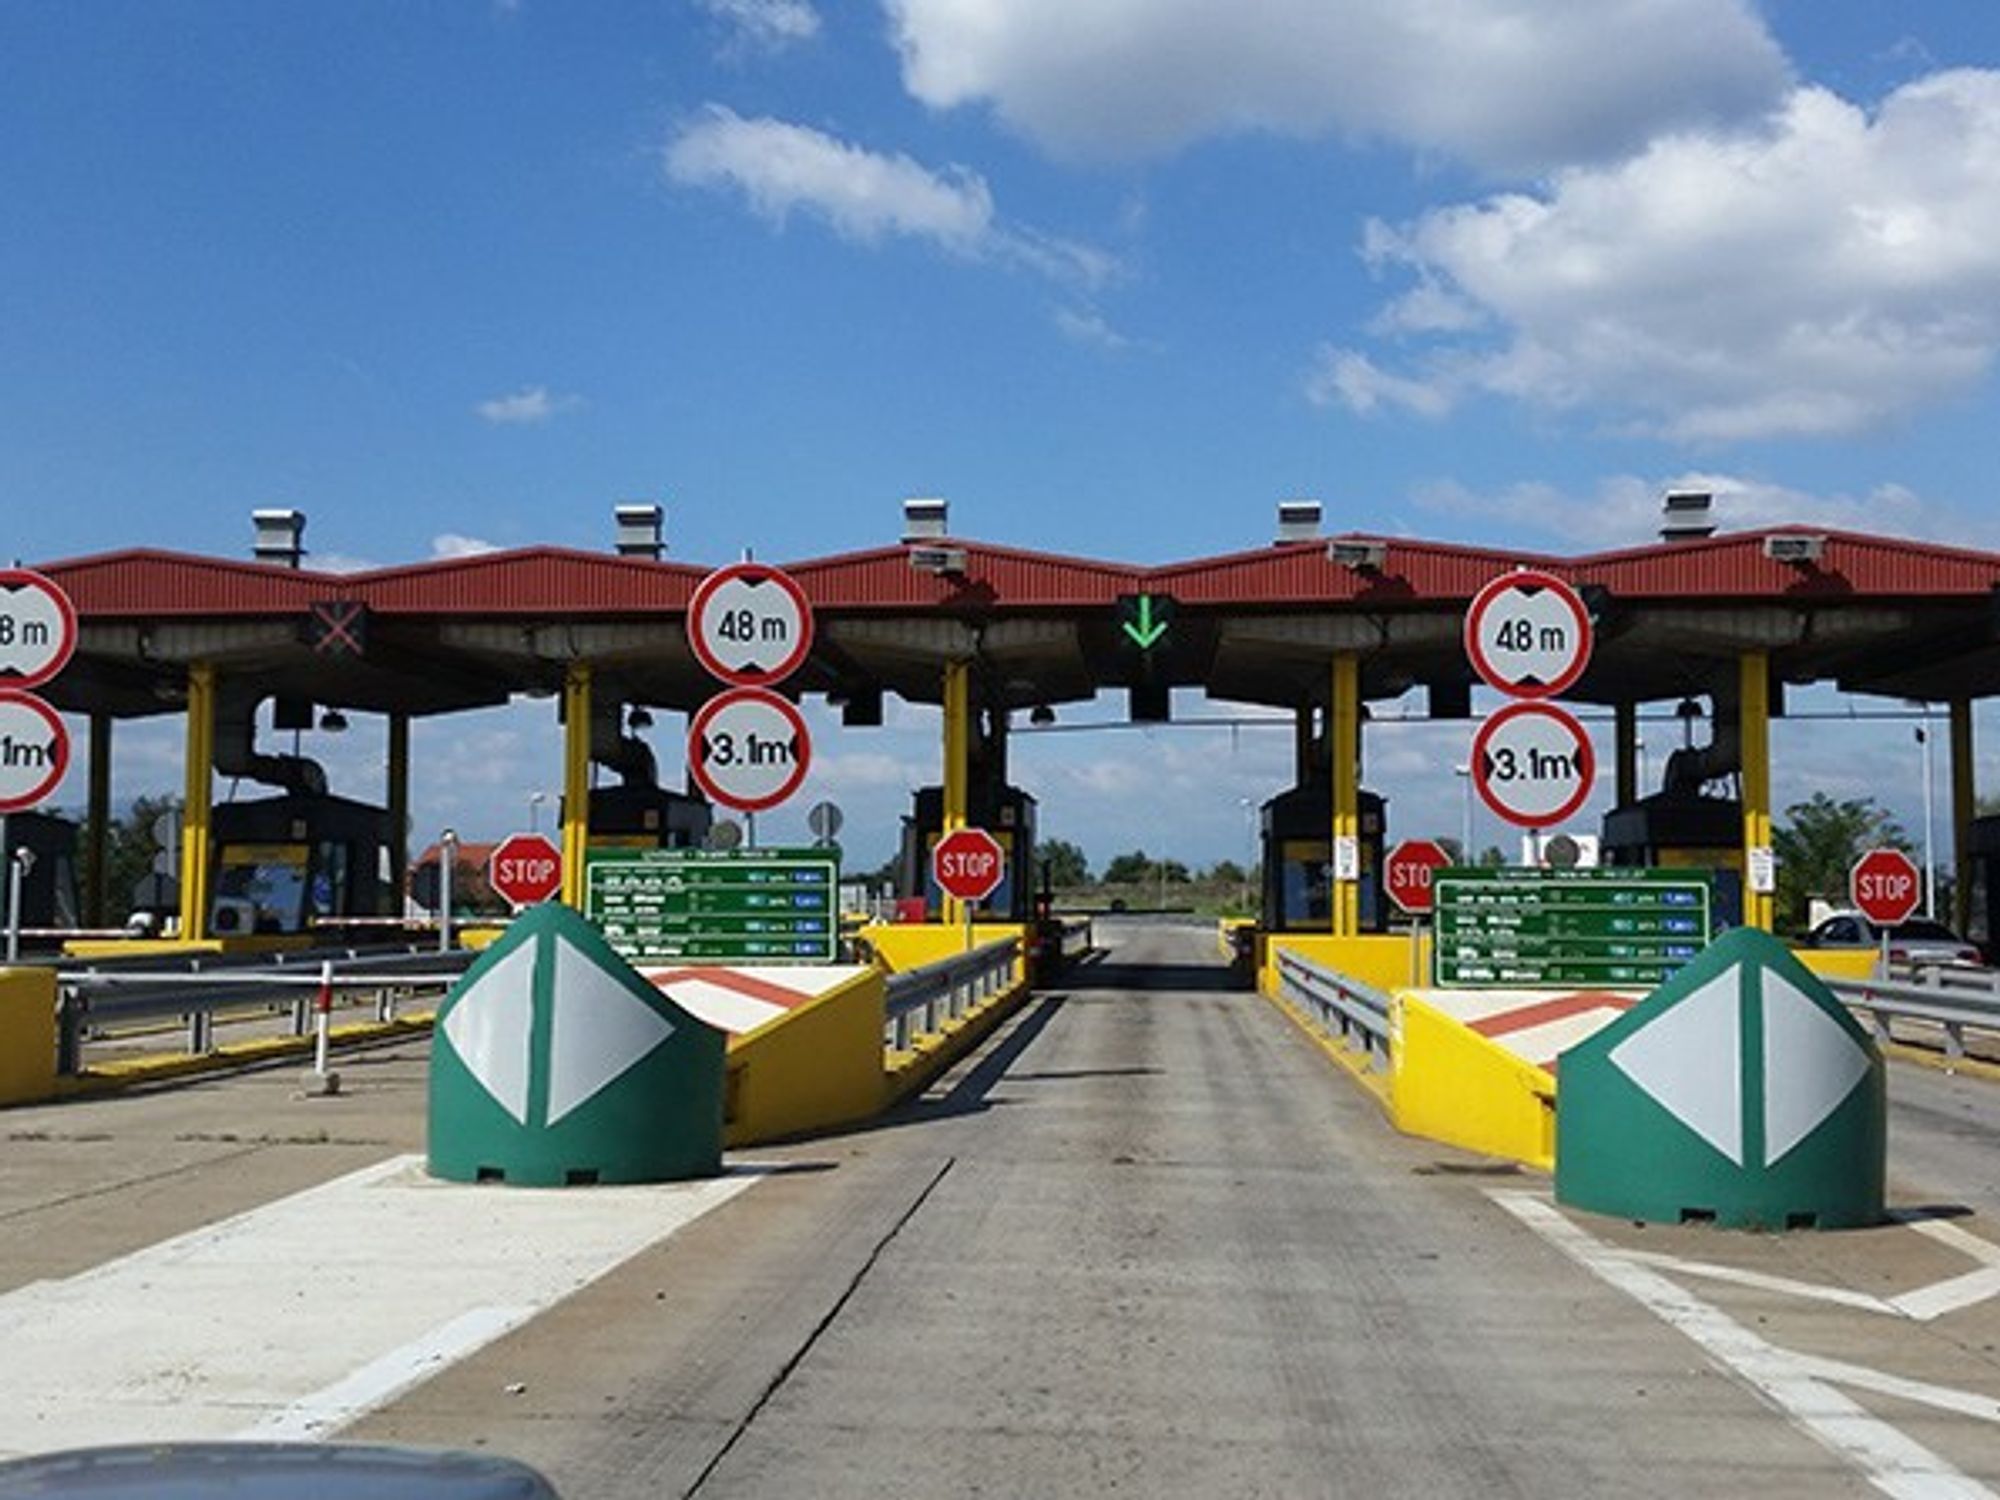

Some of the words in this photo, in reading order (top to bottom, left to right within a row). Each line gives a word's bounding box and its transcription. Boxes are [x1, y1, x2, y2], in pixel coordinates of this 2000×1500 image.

[22, 622, 48, 644] m
[762, 618, 786, 641] m
[1540, 628, 1565, 651] m
[713, 732, 787, 766] 3.1m
[1495, 747, 1571, 780] 3.1m
[499, 858, 555, 883] STOP
[943, 852, 994, 877] STOP
[1392, 862, 1431, 888] STO
[1859, 875, 1911, 900] STOP
